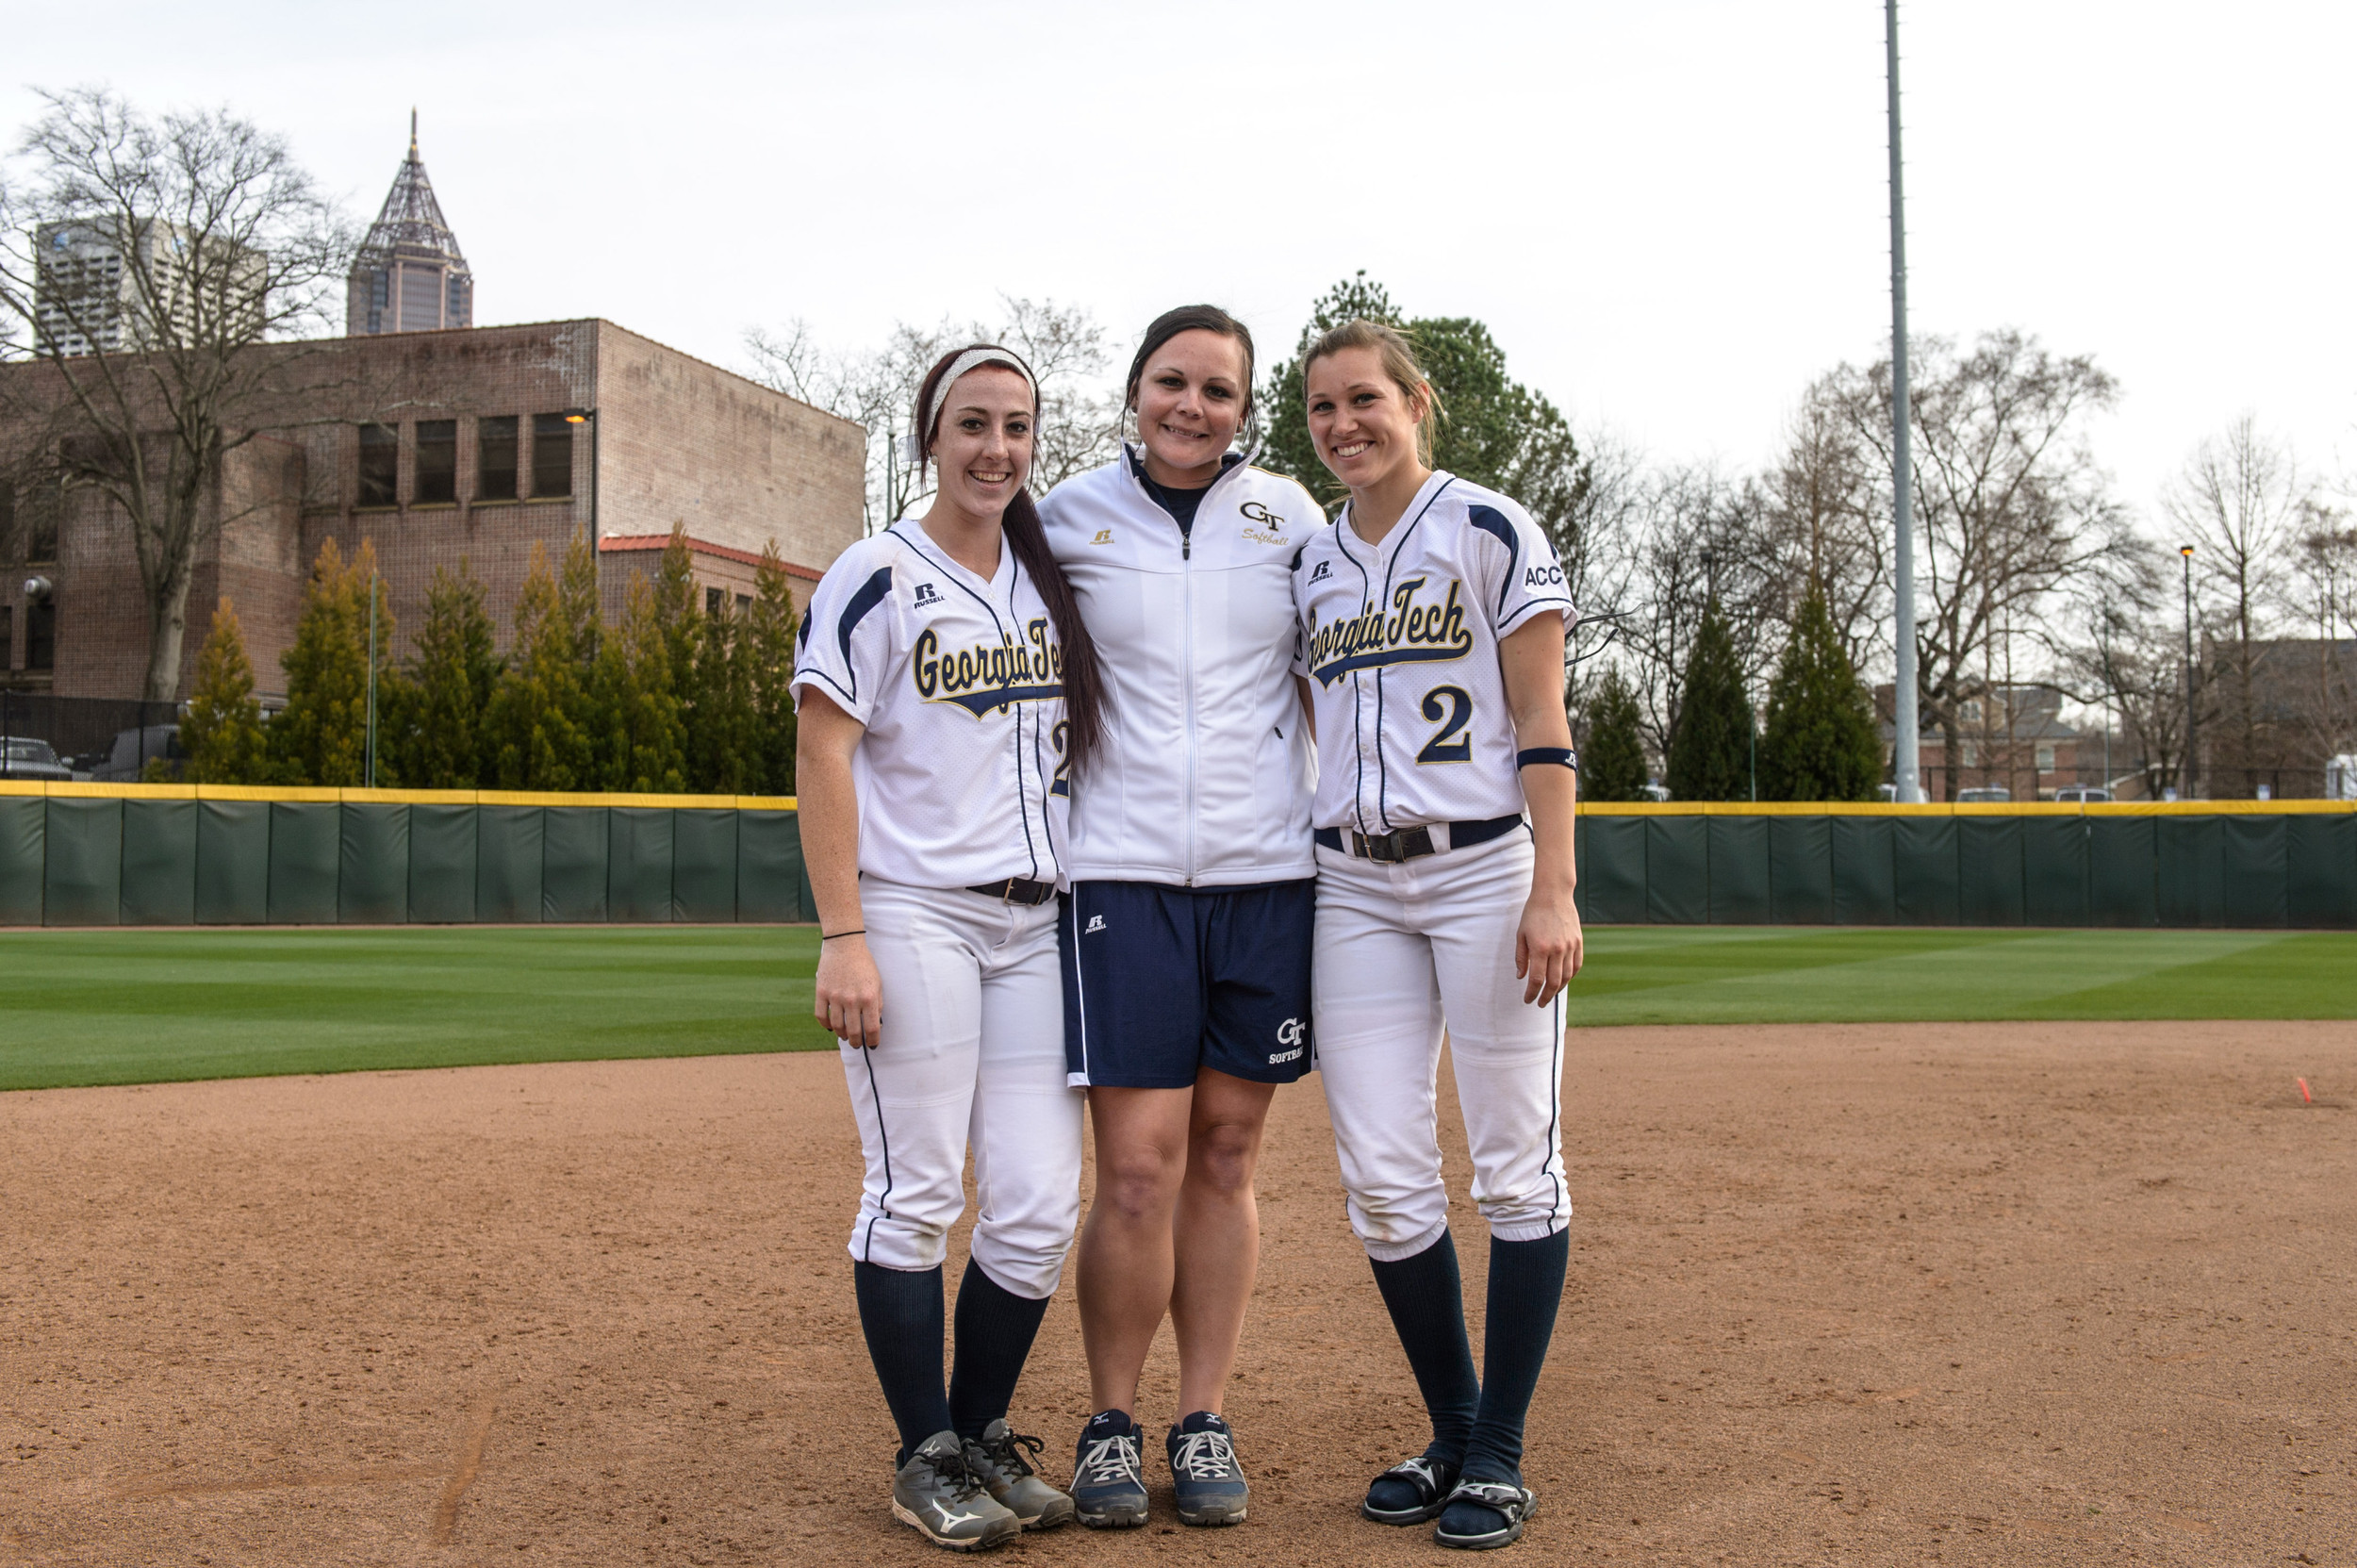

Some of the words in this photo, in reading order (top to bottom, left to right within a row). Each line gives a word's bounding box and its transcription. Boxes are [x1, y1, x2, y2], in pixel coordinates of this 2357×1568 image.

[1240, 502, 1285, 532] GT
[1242, 528, 1289, 546] Softball
[1525, 566, 1563, 586] ACC
[914, 595, 946, 609] RUSSELL
[1387, 575, 1471, 649] Tech
[914, 628, 1032, 717] Georgia
[1415, 685, 1473, 767] 2
[1277, 1017, 1306, 1046] GT
